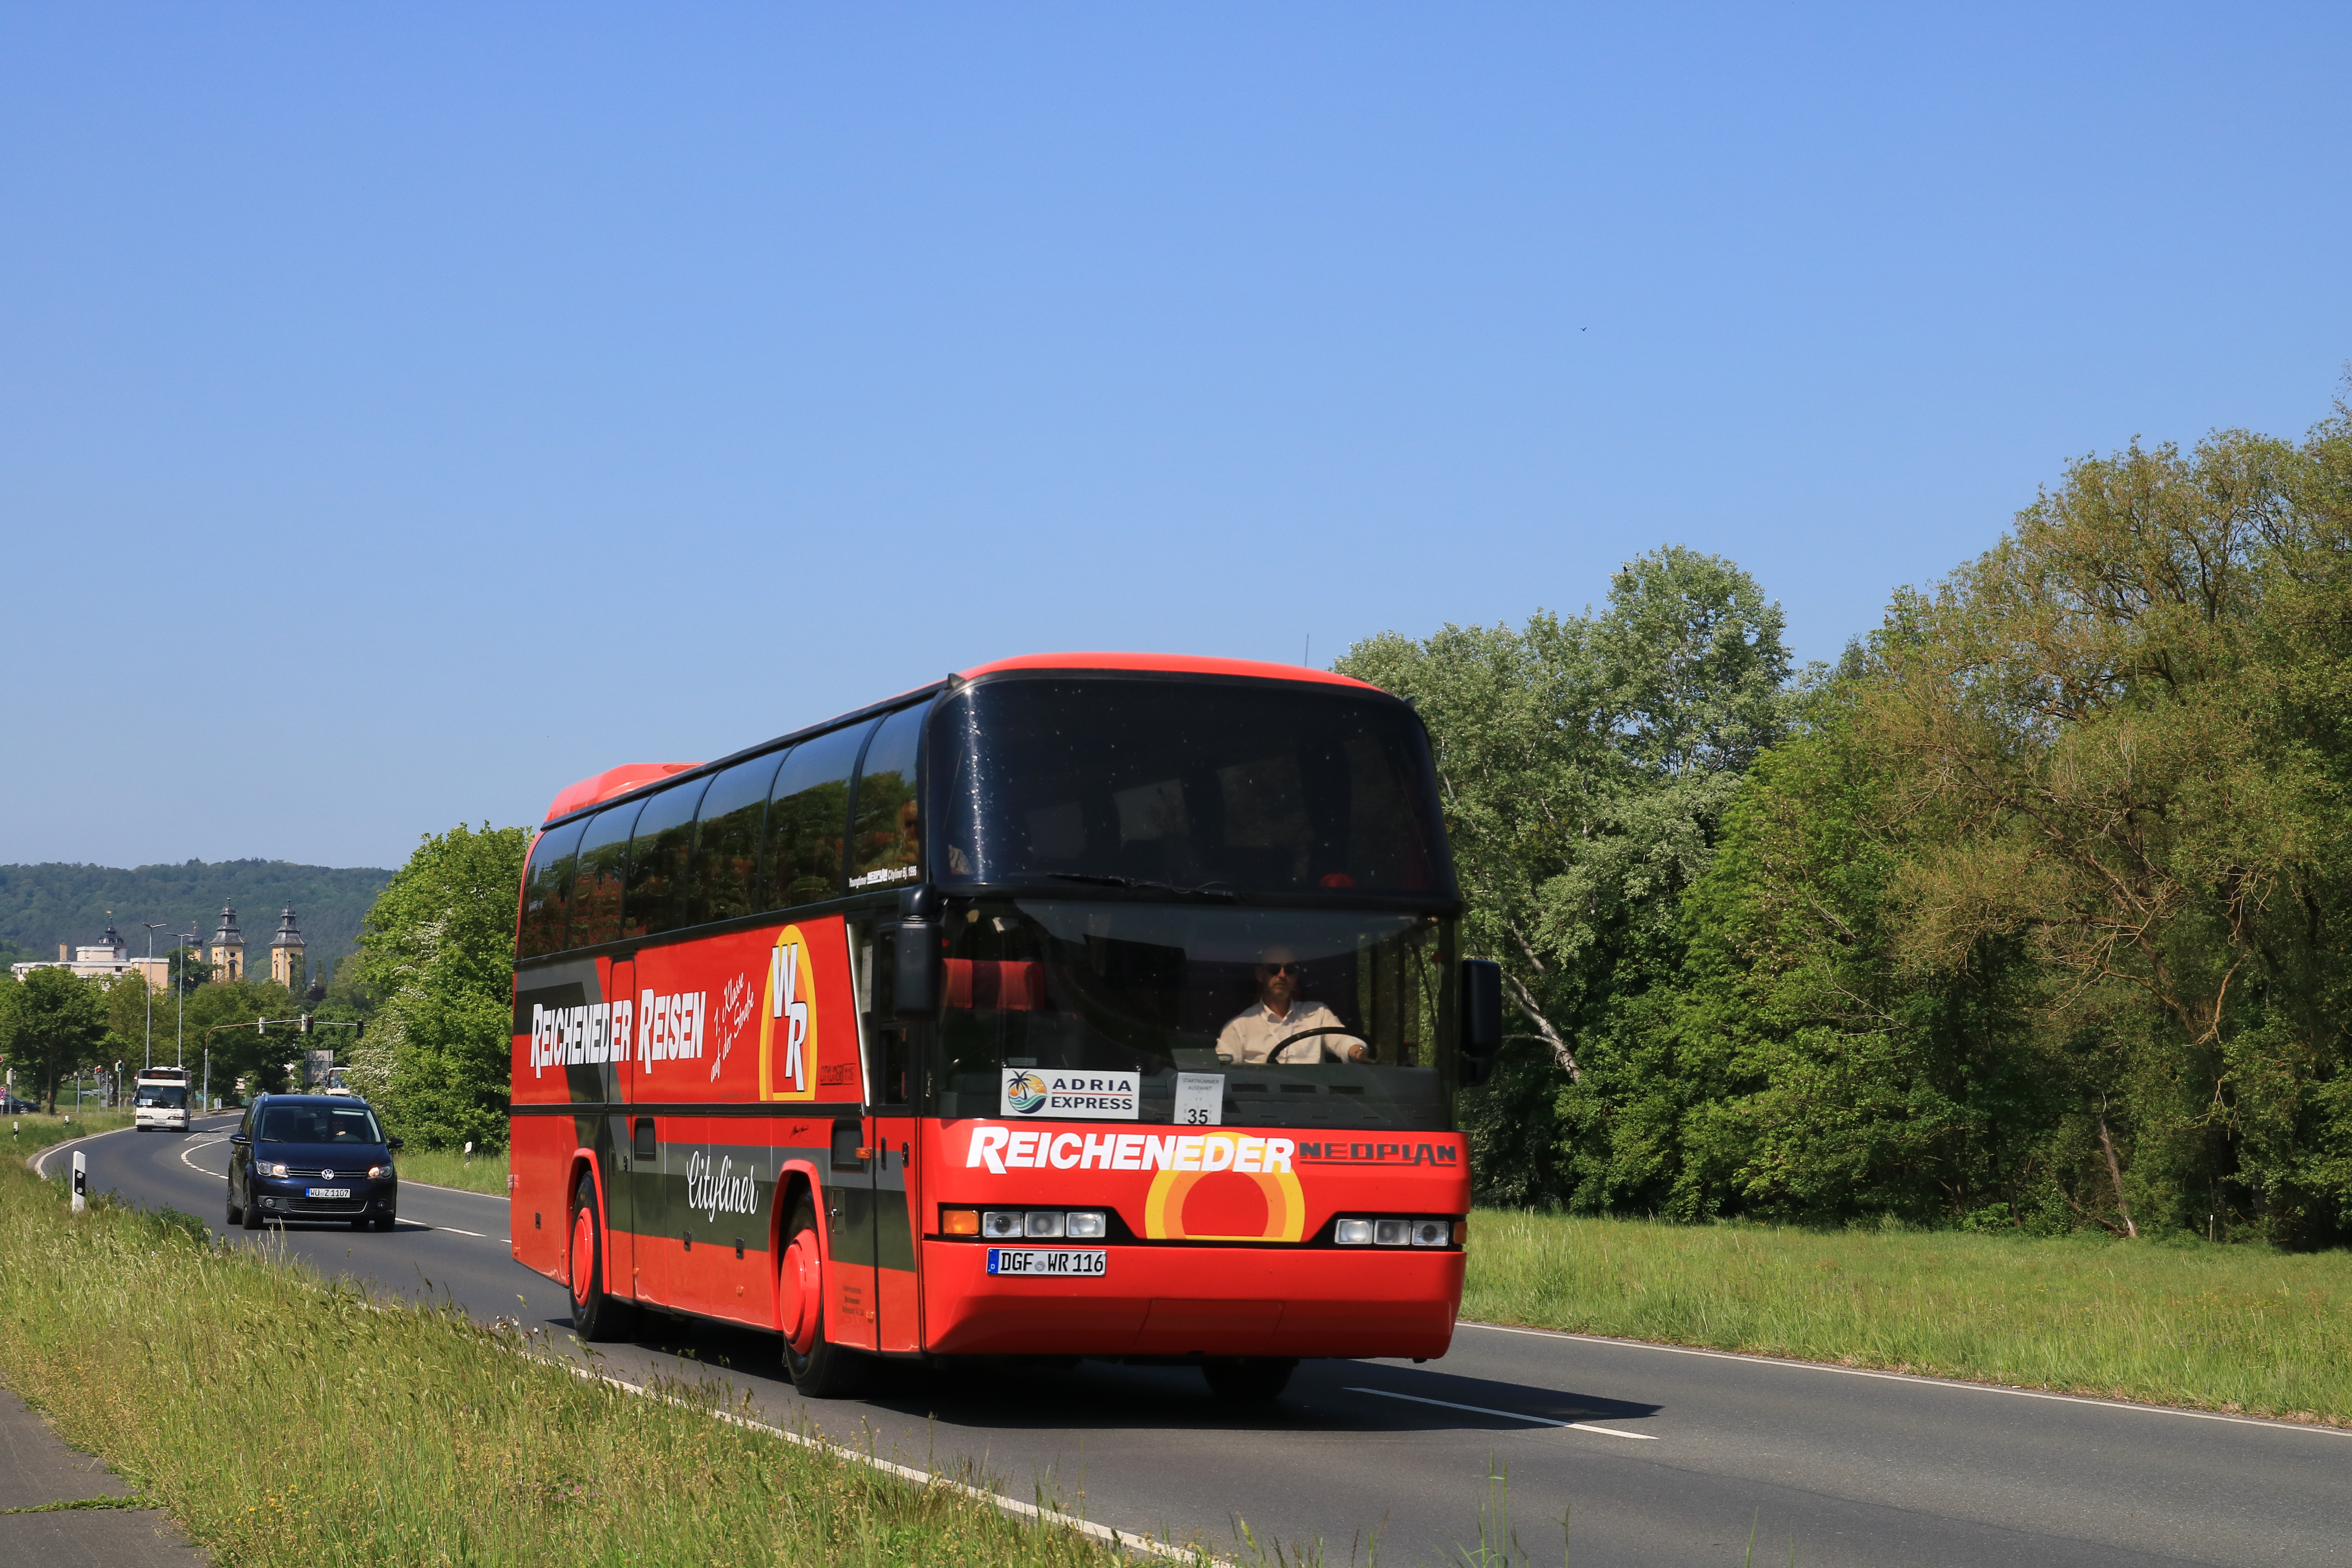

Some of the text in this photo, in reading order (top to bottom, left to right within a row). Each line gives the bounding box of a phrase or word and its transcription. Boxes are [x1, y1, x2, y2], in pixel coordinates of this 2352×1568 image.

[867, 868, 888, 885] NEOPLAN
[714, 972, 744, 1037] 1. Klasse
[772, 942, 808, 1092] WR
[530, 989, 706, 1078] REICHENEDER REISEN
[710, 981, 754, 1083] auf der Straße
[1051, 1096, 1132, 1110] EXPRESS
[1052, 1078, 1132, 1092] ADRIA
[1187, 1108, 1208, 1124] 35
[966, 1126, 1295, 1174] REICHENEDER
[1299, 1142, 1457, 1166] NEOPLAN
[686, 1150, 759, 1223] Cityliner
[1000, 1252, 1034, 1271] DGF
[1047, 1253, 1069, 1272] WR
[1072, 1253, 1103, 1272] 116
